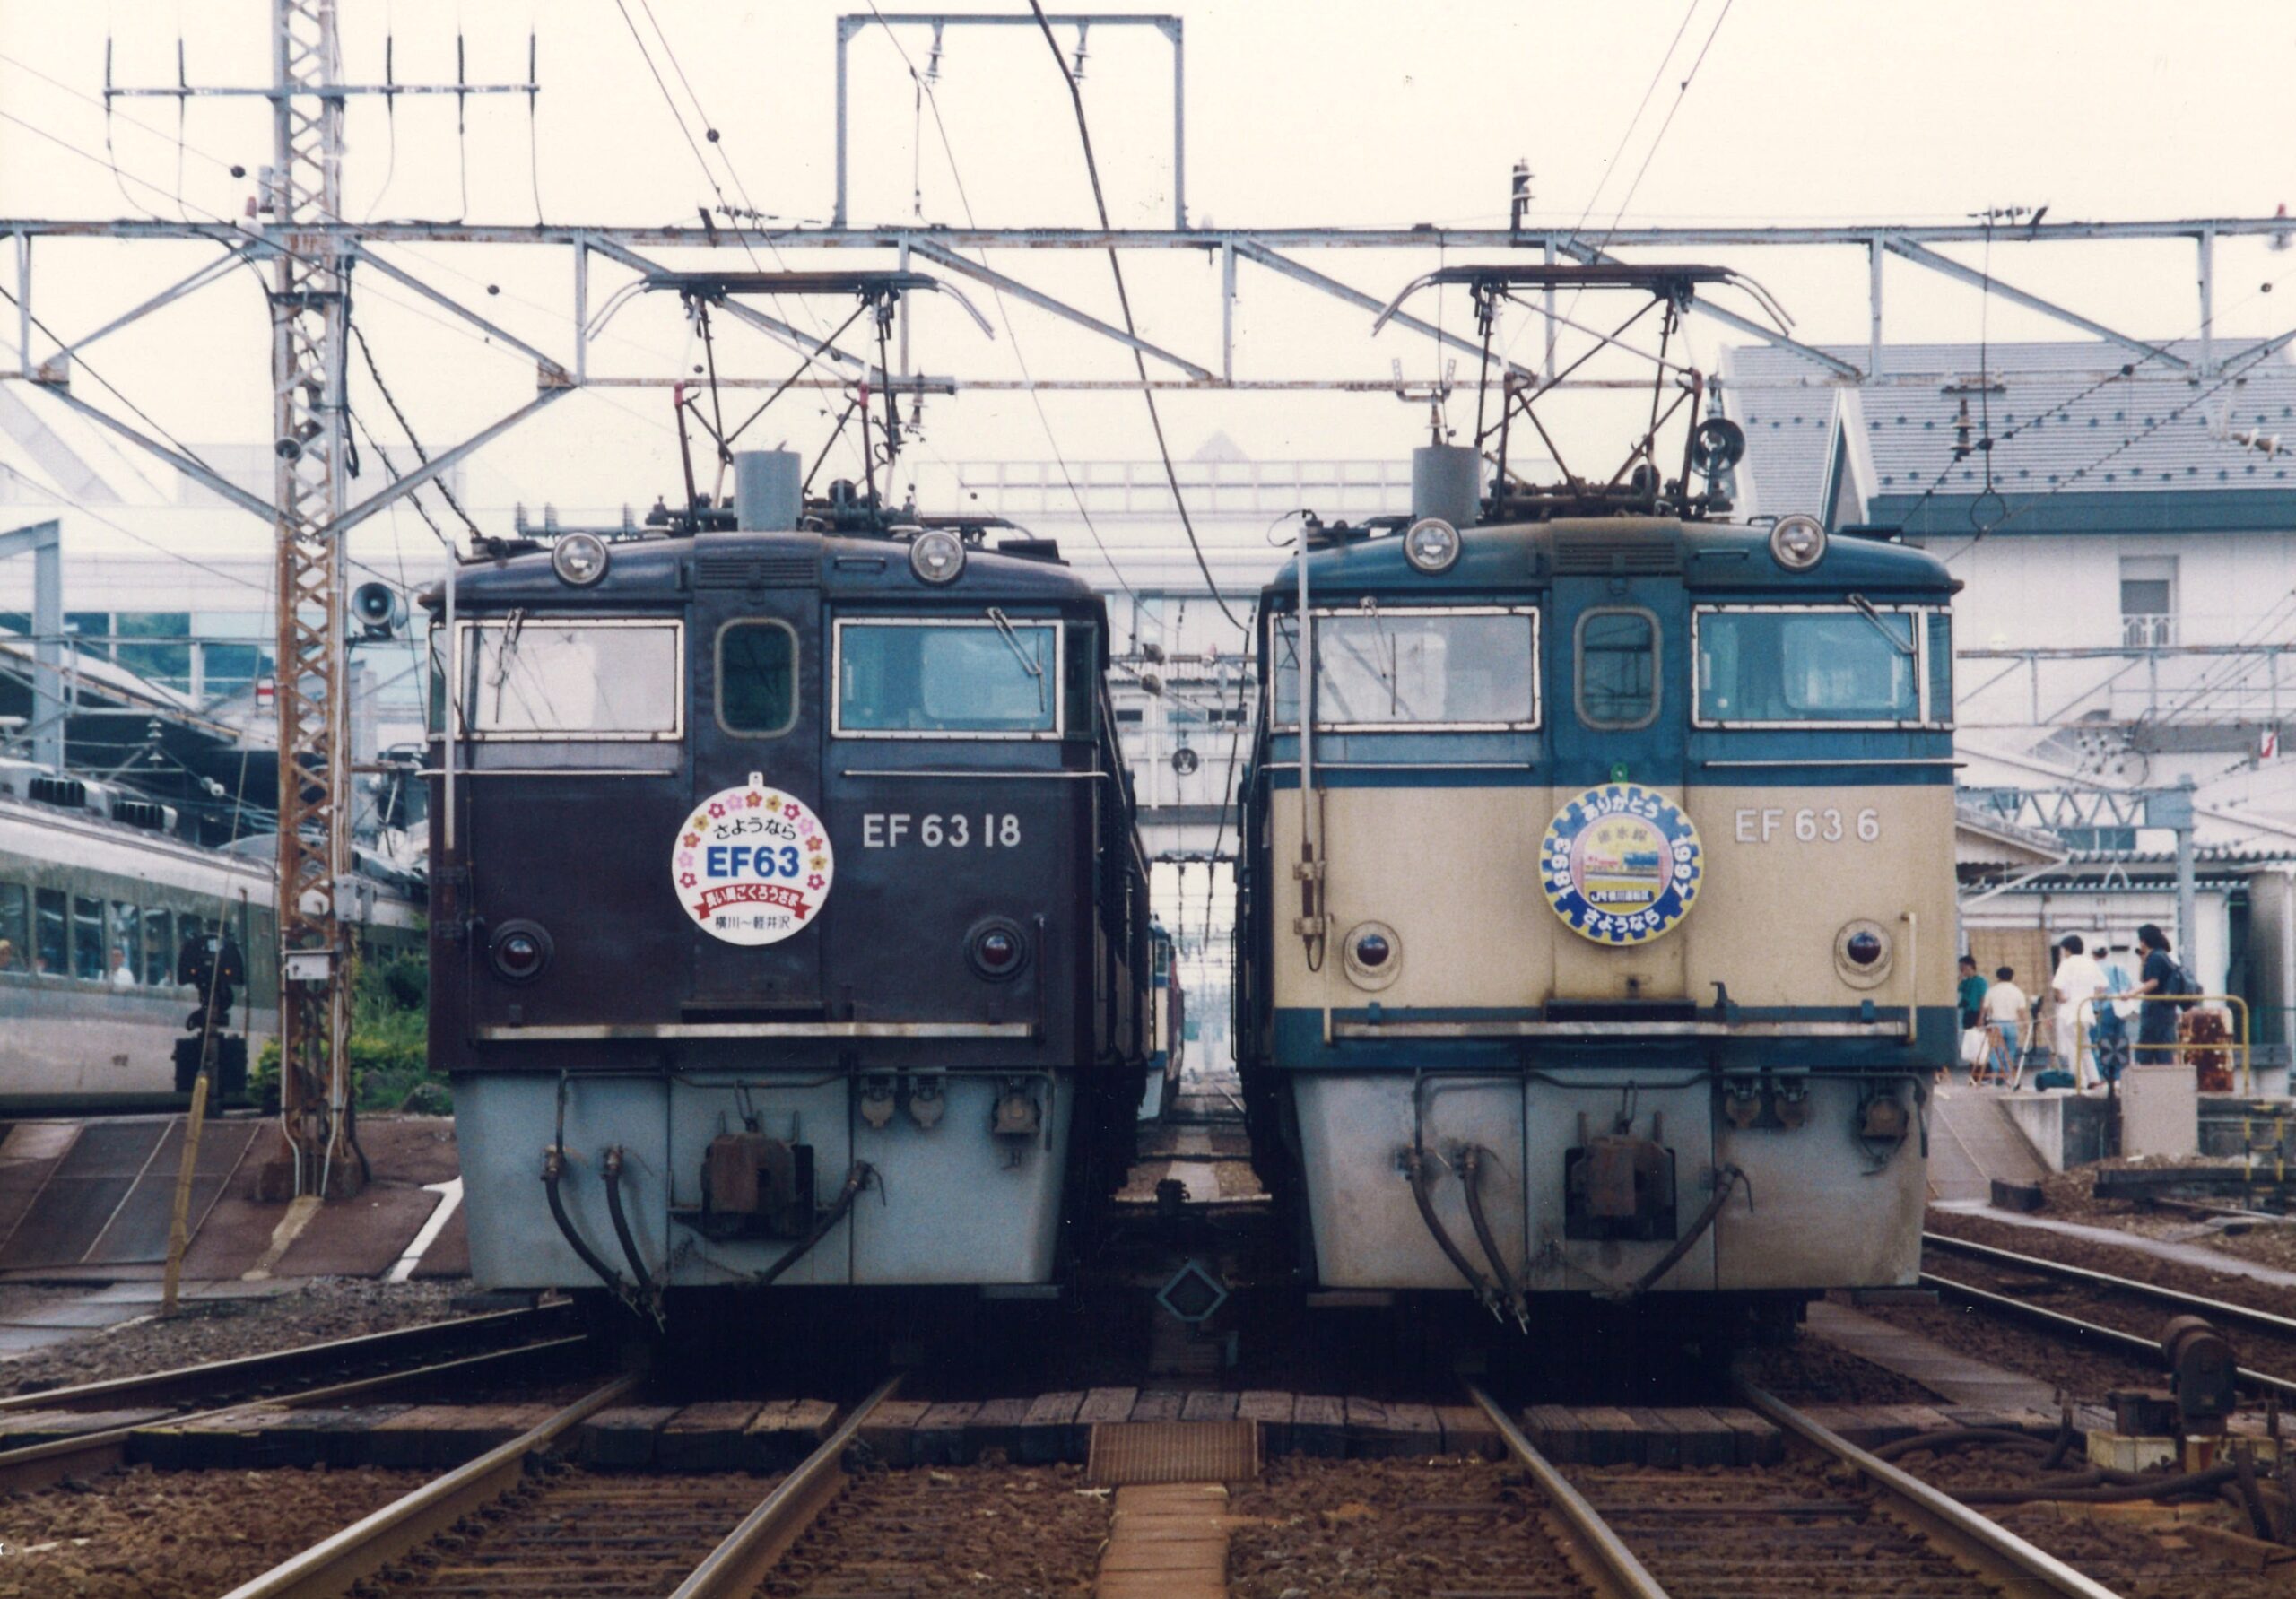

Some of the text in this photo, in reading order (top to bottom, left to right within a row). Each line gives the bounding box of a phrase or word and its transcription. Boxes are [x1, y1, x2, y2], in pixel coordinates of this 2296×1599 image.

[1582, 795, 1659, 821] ありがとう
[713, 816, 796, 840] さようなら
[985, 813, 1021, 847] 18
[1857, 808, 1880, 842] 6
[706, 846, 800, 878] EF63
[1551, 838, 1574, 899] 1893
[1671, 833, 1692, 899] 1997
[1583, 908, 1660, 933] さようなら
